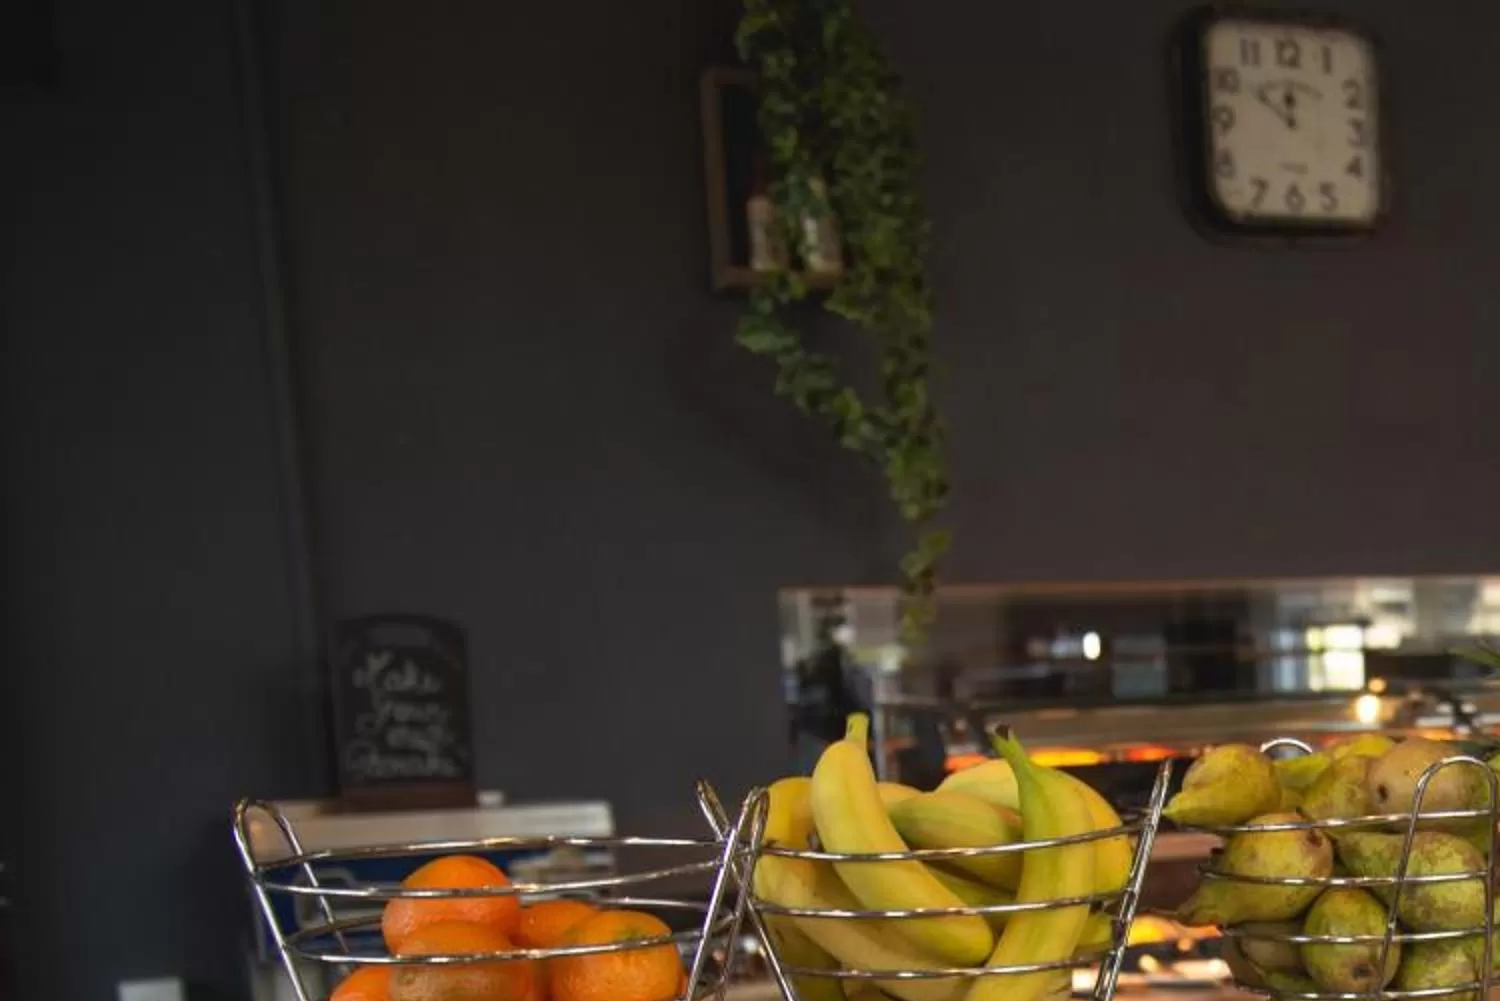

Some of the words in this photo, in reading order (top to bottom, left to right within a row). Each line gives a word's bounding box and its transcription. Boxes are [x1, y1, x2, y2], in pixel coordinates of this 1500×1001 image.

[1275, 38, 1301, 69] 12
[1322, 45, 1333, 76] 1
[1250, 178, 1270, 209] 7
[1286, 183, 1306, 212] 6
